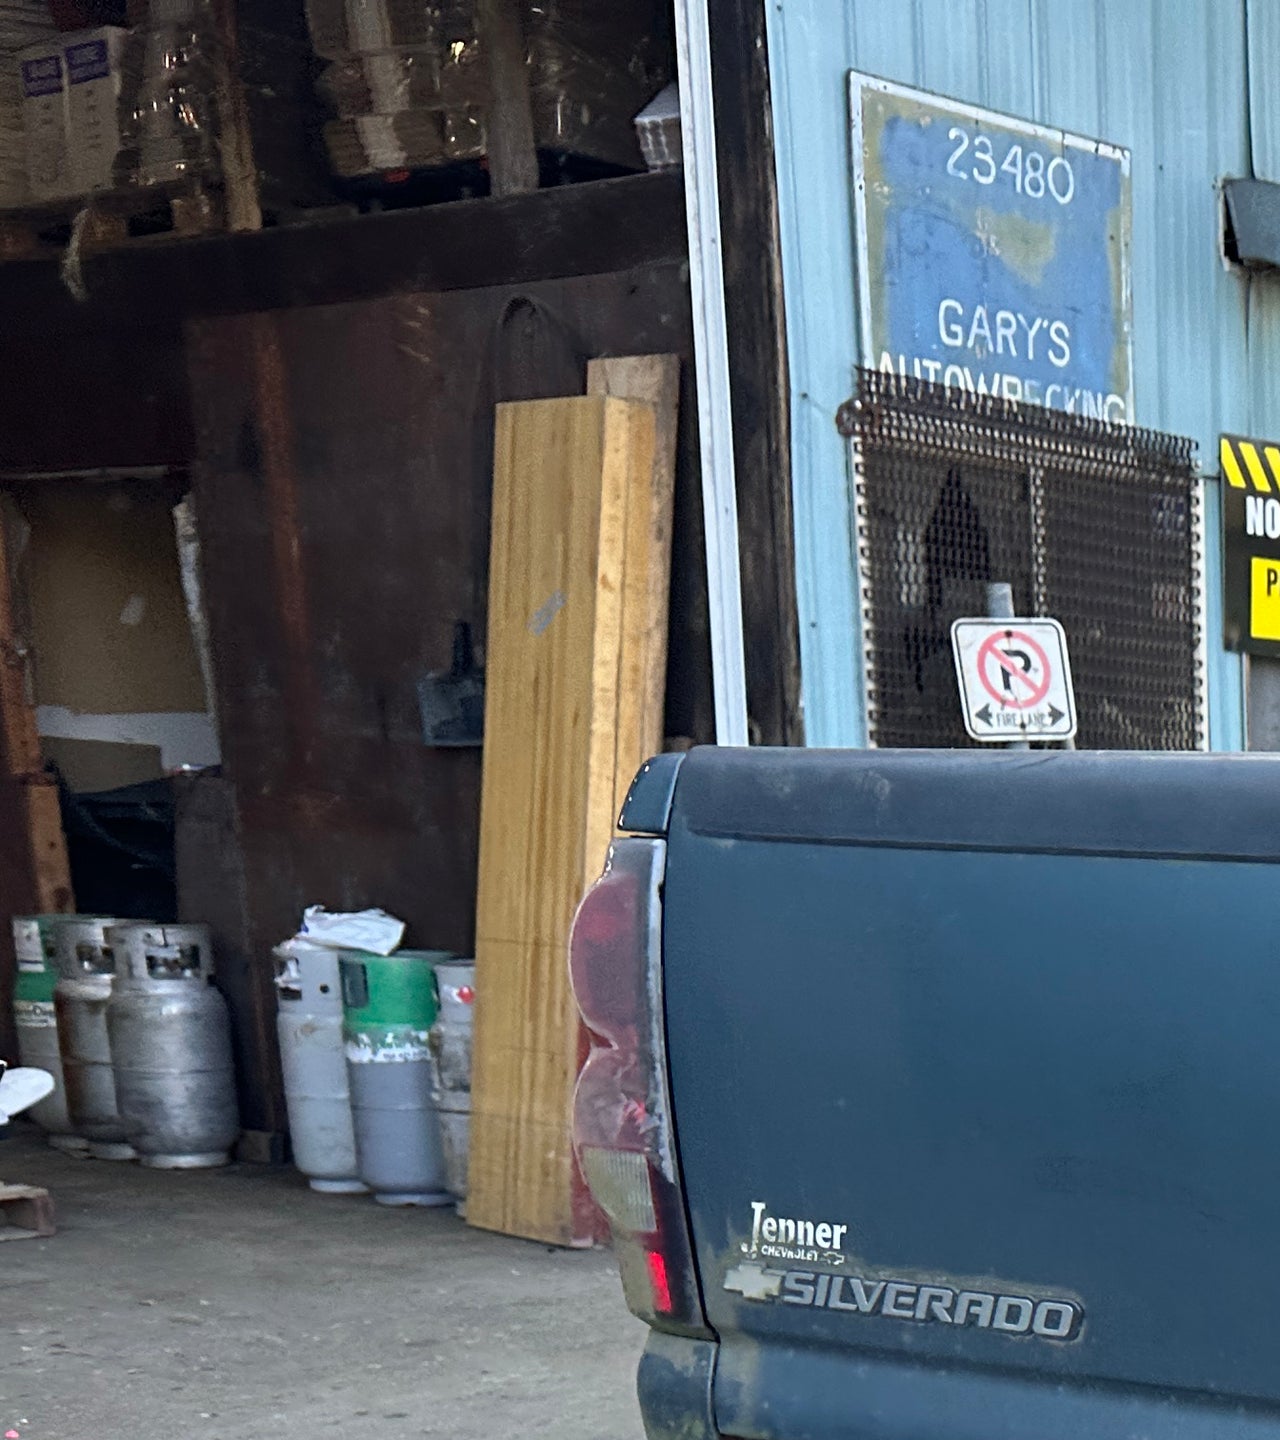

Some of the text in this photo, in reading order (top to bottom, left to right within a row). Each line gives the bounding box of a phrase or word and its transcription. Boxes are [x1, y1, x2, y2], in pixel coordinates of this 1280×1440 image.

[946, 127, 1074, 205] 23480
[938, 299, 1070, 367] GARY'S
[1245, 495, 1280, 539] NO
[996, 711, 1017, 727] FIRE
[783, 1270, 1075, 1339] SILVERADO
